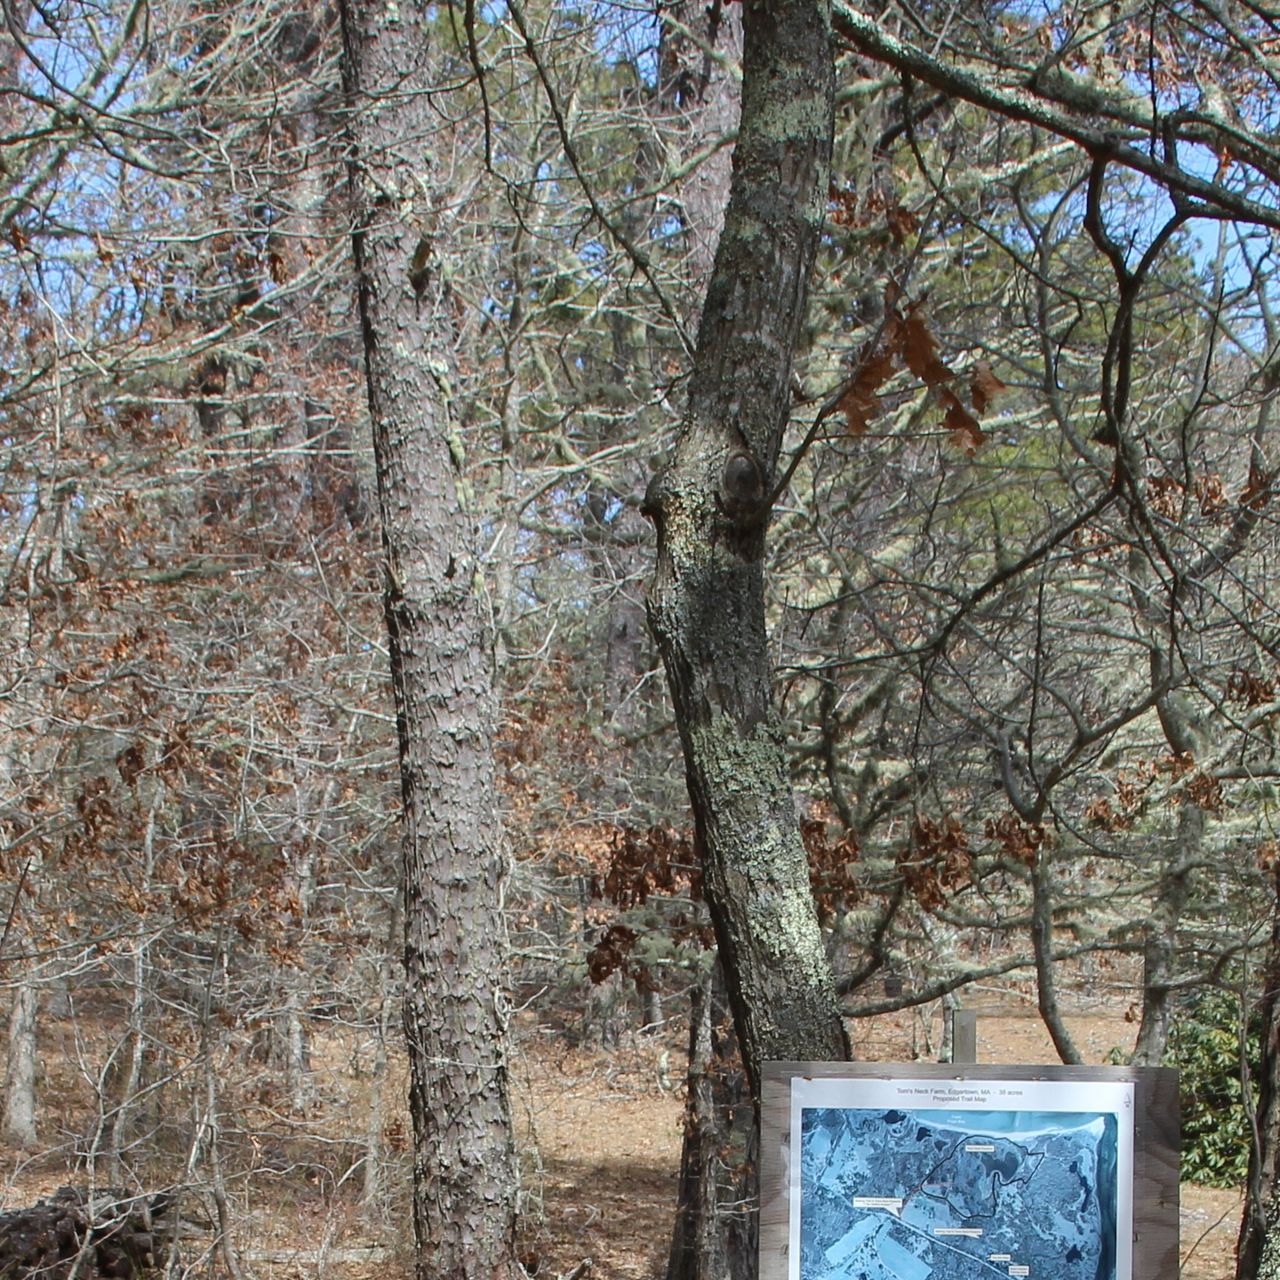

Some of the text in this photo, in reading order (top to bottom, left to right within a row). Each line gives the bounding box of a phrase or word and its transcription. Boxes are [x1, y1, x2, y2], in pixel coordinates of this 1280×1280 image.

[915, 1087, 929, 1095] Neck
[981, 1088, 991, 1096] MA
[974, 1096, 987, 1104] Map
